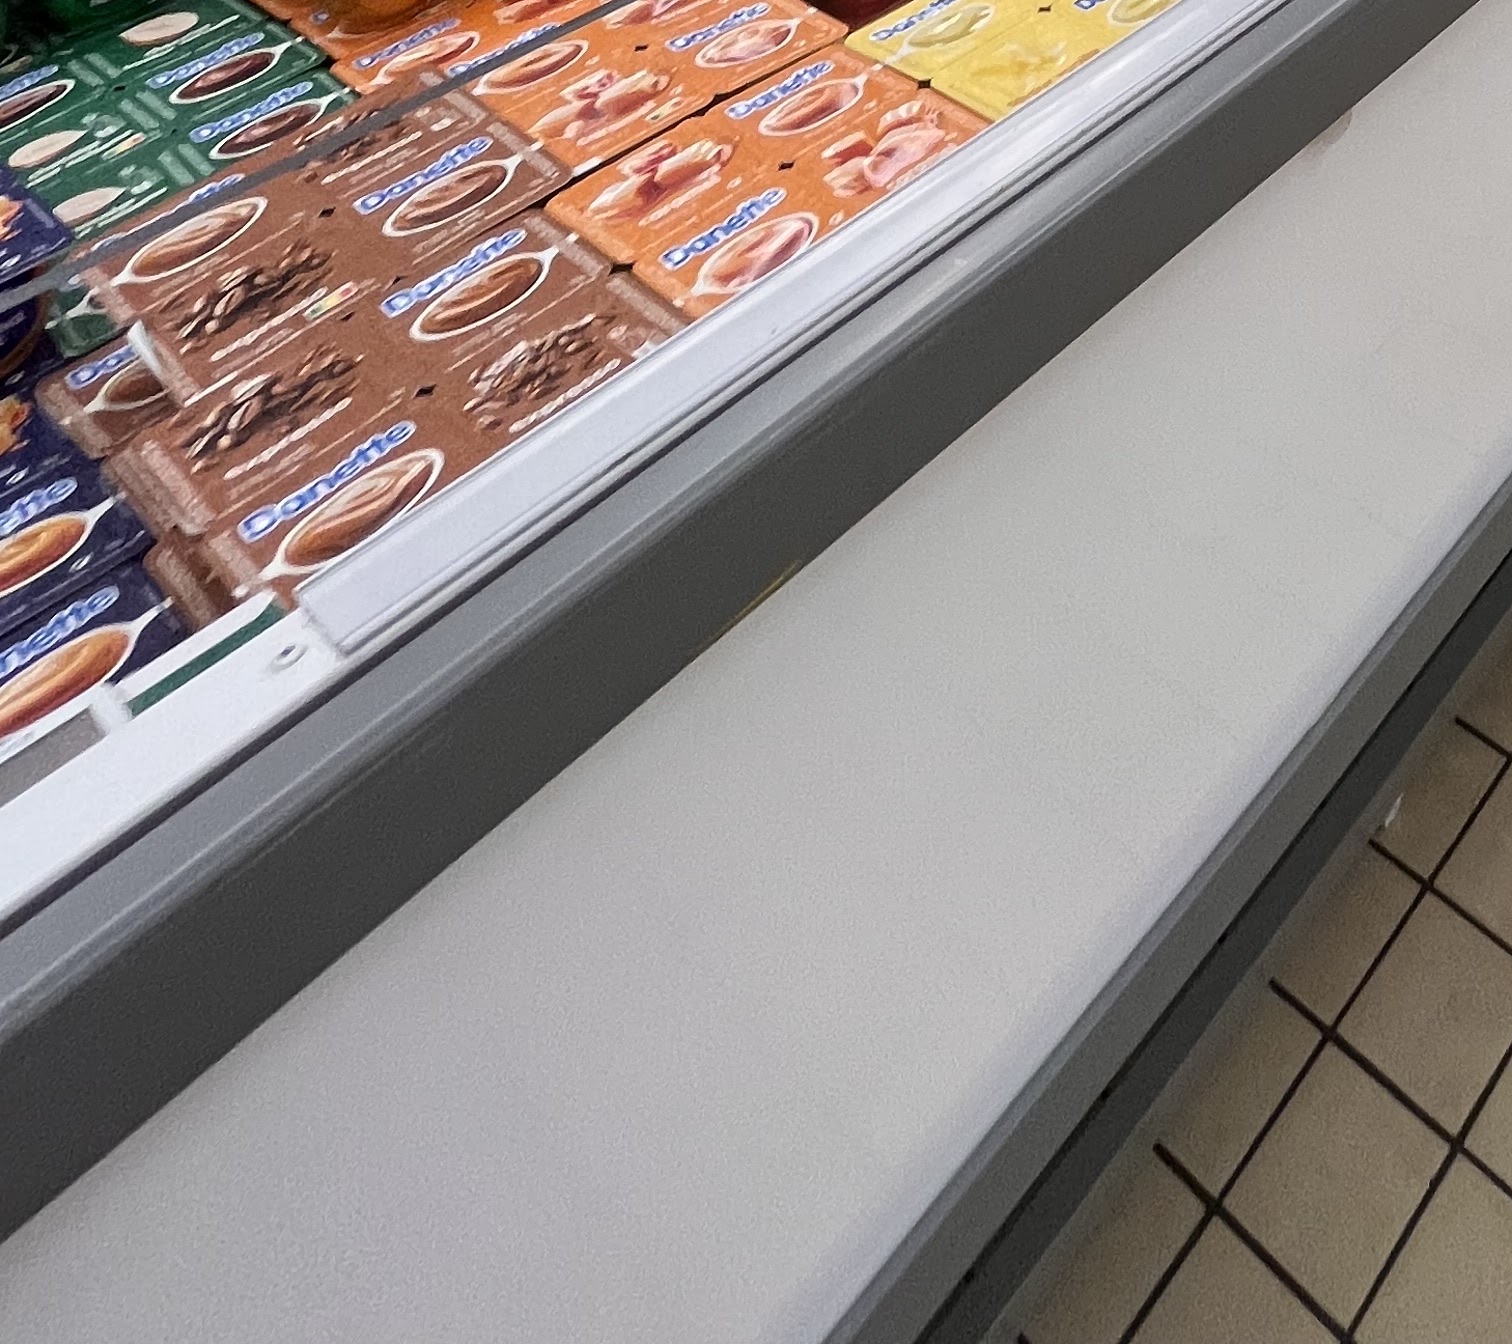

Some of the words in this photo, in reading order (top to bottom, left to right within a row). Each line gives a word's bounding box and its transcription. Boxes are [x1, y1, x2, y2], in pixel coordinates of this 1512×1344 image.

[726, 60, 834, 120] Danette
[353, 135, 494, 216] Danette
[658, 186, 787, 269] Danette
[380, 227, 529, 319] Danette
[237, 419, 418, 544] Danette
